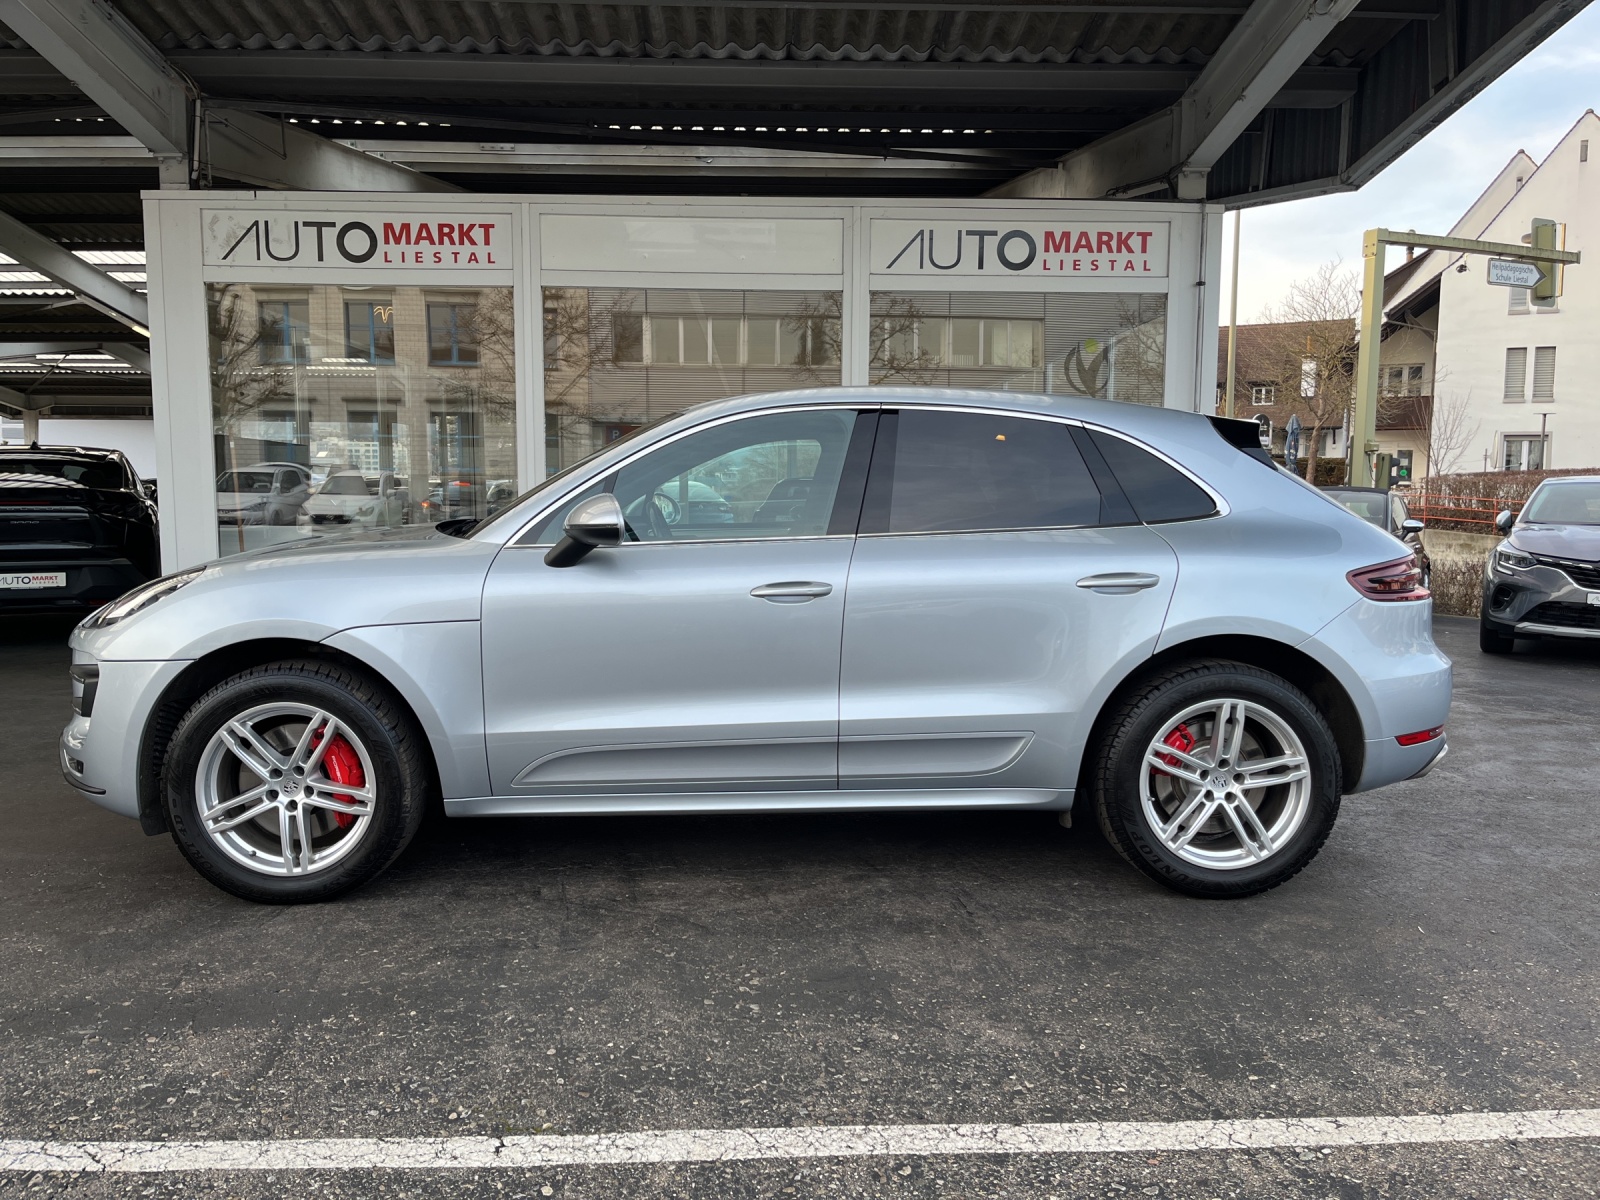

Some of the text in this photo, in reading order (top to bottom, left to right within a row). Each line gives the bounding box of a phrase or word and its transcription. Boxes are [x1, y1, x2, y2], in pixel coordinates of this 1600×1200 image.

[221, 219, 496, 264] AUTO MARKT
[383, 250, 497, 265] LIESTAL
[886, 229, 1153, 271] AUTO MARKT
[1042, 258, 1152, 273] LIESTAL
[1491, 262, 1534, 275] Heilpädagogische
[1495, 273, 1529, 284] Schule Liestal
[612, 430, 620, 440] P
